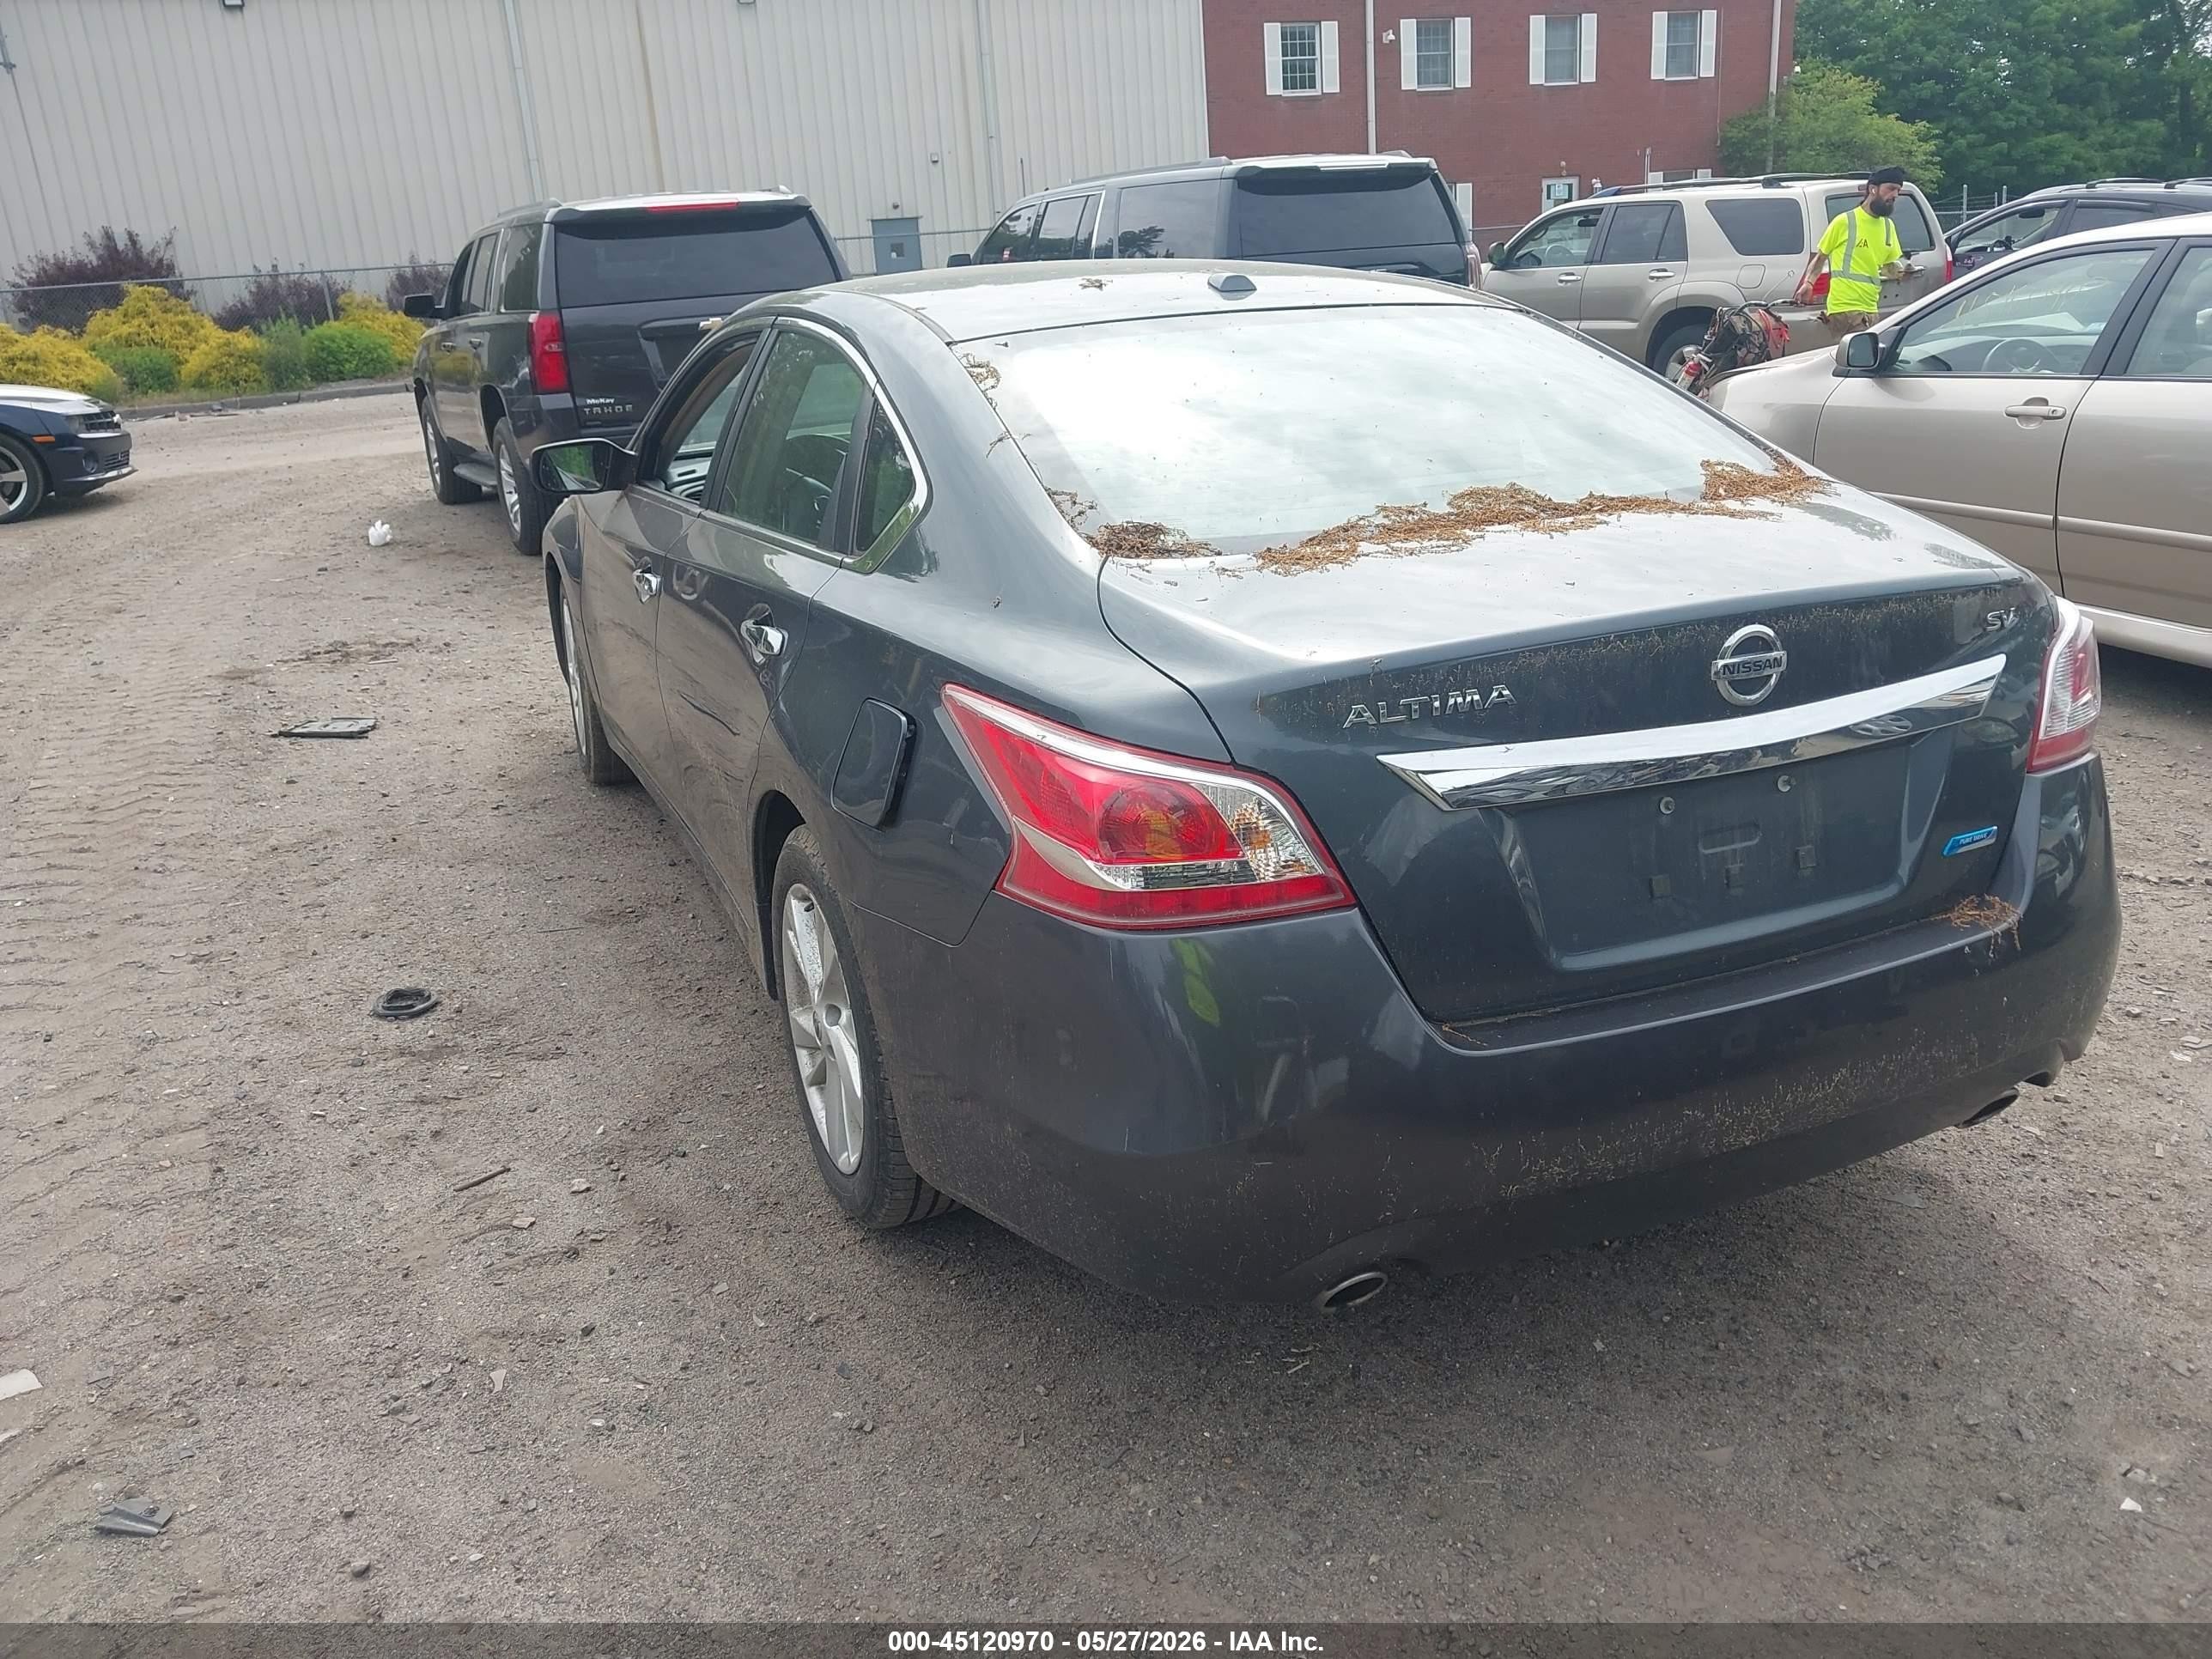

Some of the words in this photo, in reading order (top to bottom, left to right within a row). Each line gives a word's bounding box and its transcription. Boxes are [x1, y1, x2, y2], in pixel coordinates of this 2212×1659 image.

[584, 404, 632, 415] TAHOE
[1985, 606, 2020, 632] SV
[1722, 655, 1784, 676] NISSAN
[1342, 684, 1517, 729] ALTIMA
